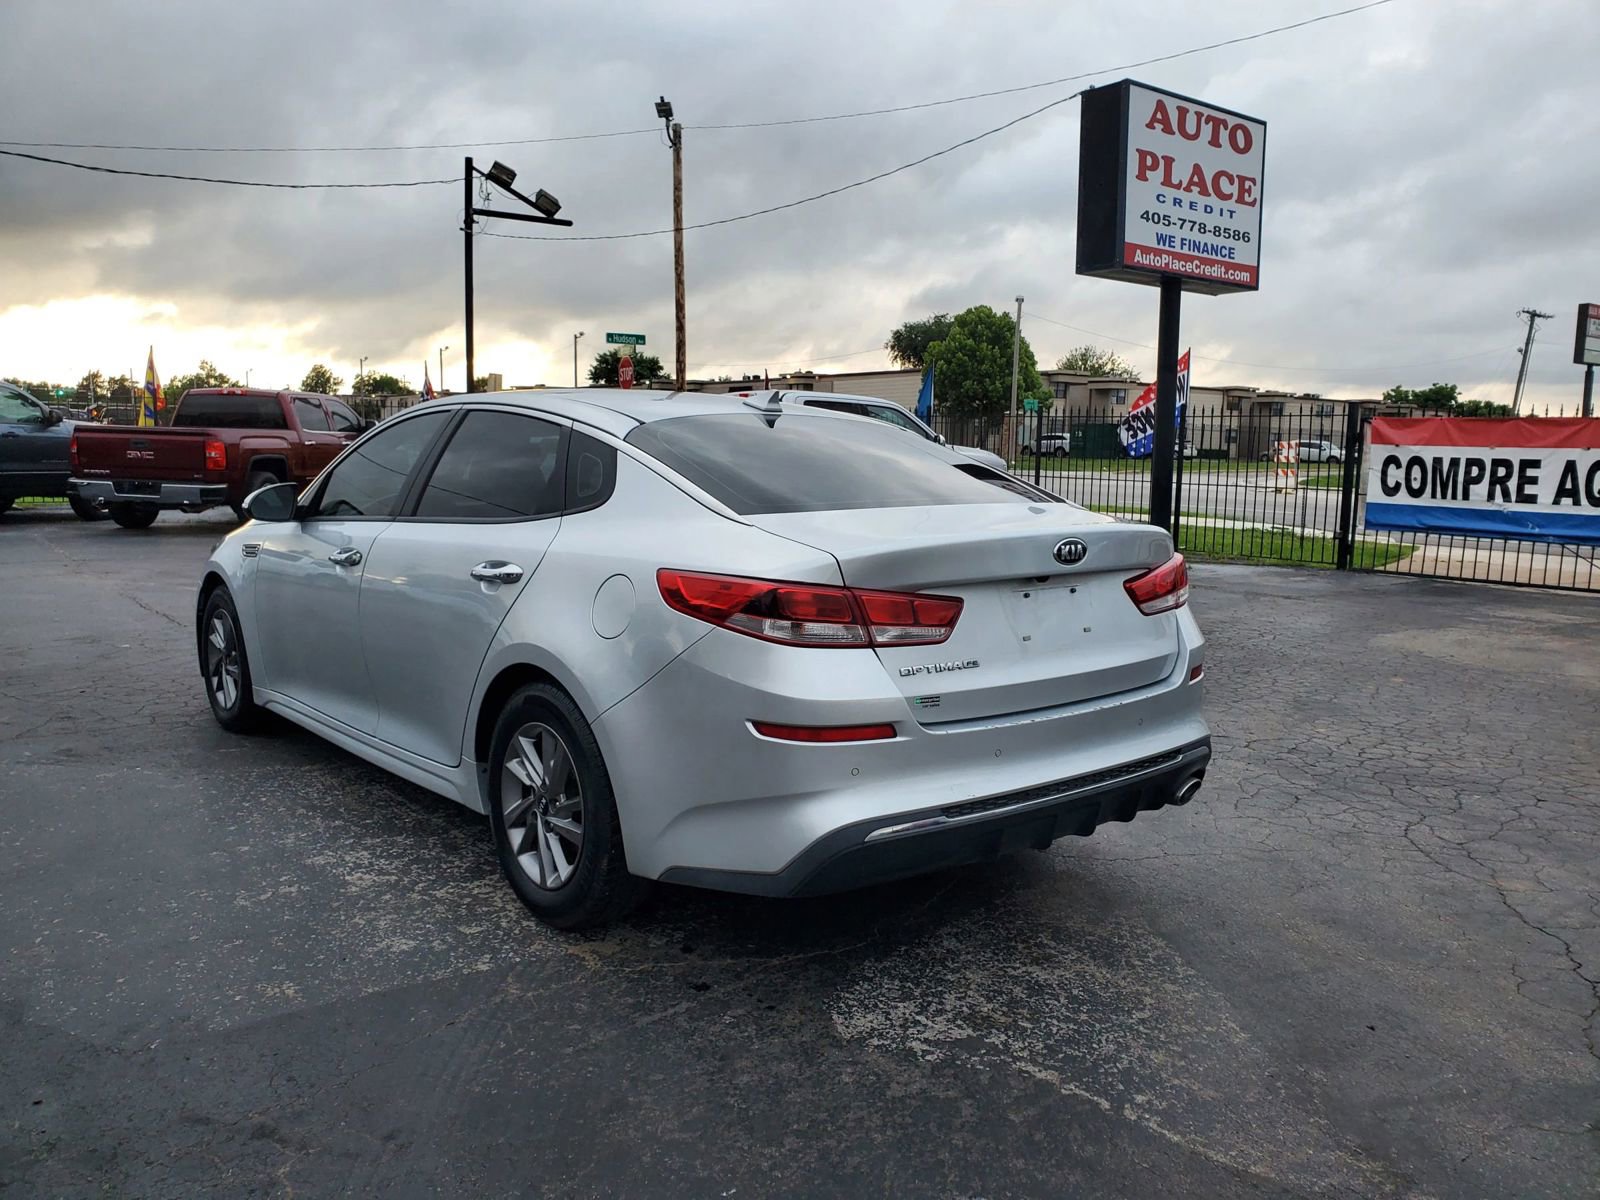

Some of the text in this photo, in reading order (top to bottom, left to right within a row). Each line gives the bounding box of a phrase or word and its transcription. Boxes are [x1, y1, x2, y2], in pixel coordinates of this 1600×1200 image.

[1145, 99, 1253, 154] AUTO
[1135, 148, 1257, 207] PLACE
[1156, 193, 1236, 219] CREDIT
[1140, 210, 1251, 243] 405-778-8586
[1156, 231, 1235, 260] WE FINANCE
[1134, 249, 1250, 282] AutoPlaceCredit.com
[613, 334, 637, 344] Hudson
[620, 367, 633, 381] STOP
[127, 451, 154, 459] GMC
[1380, 454, 1542, 505] COMPRE
[1061, 544, 1084, 560] KIA
[899, 661, 963, 677] OPTIMA
